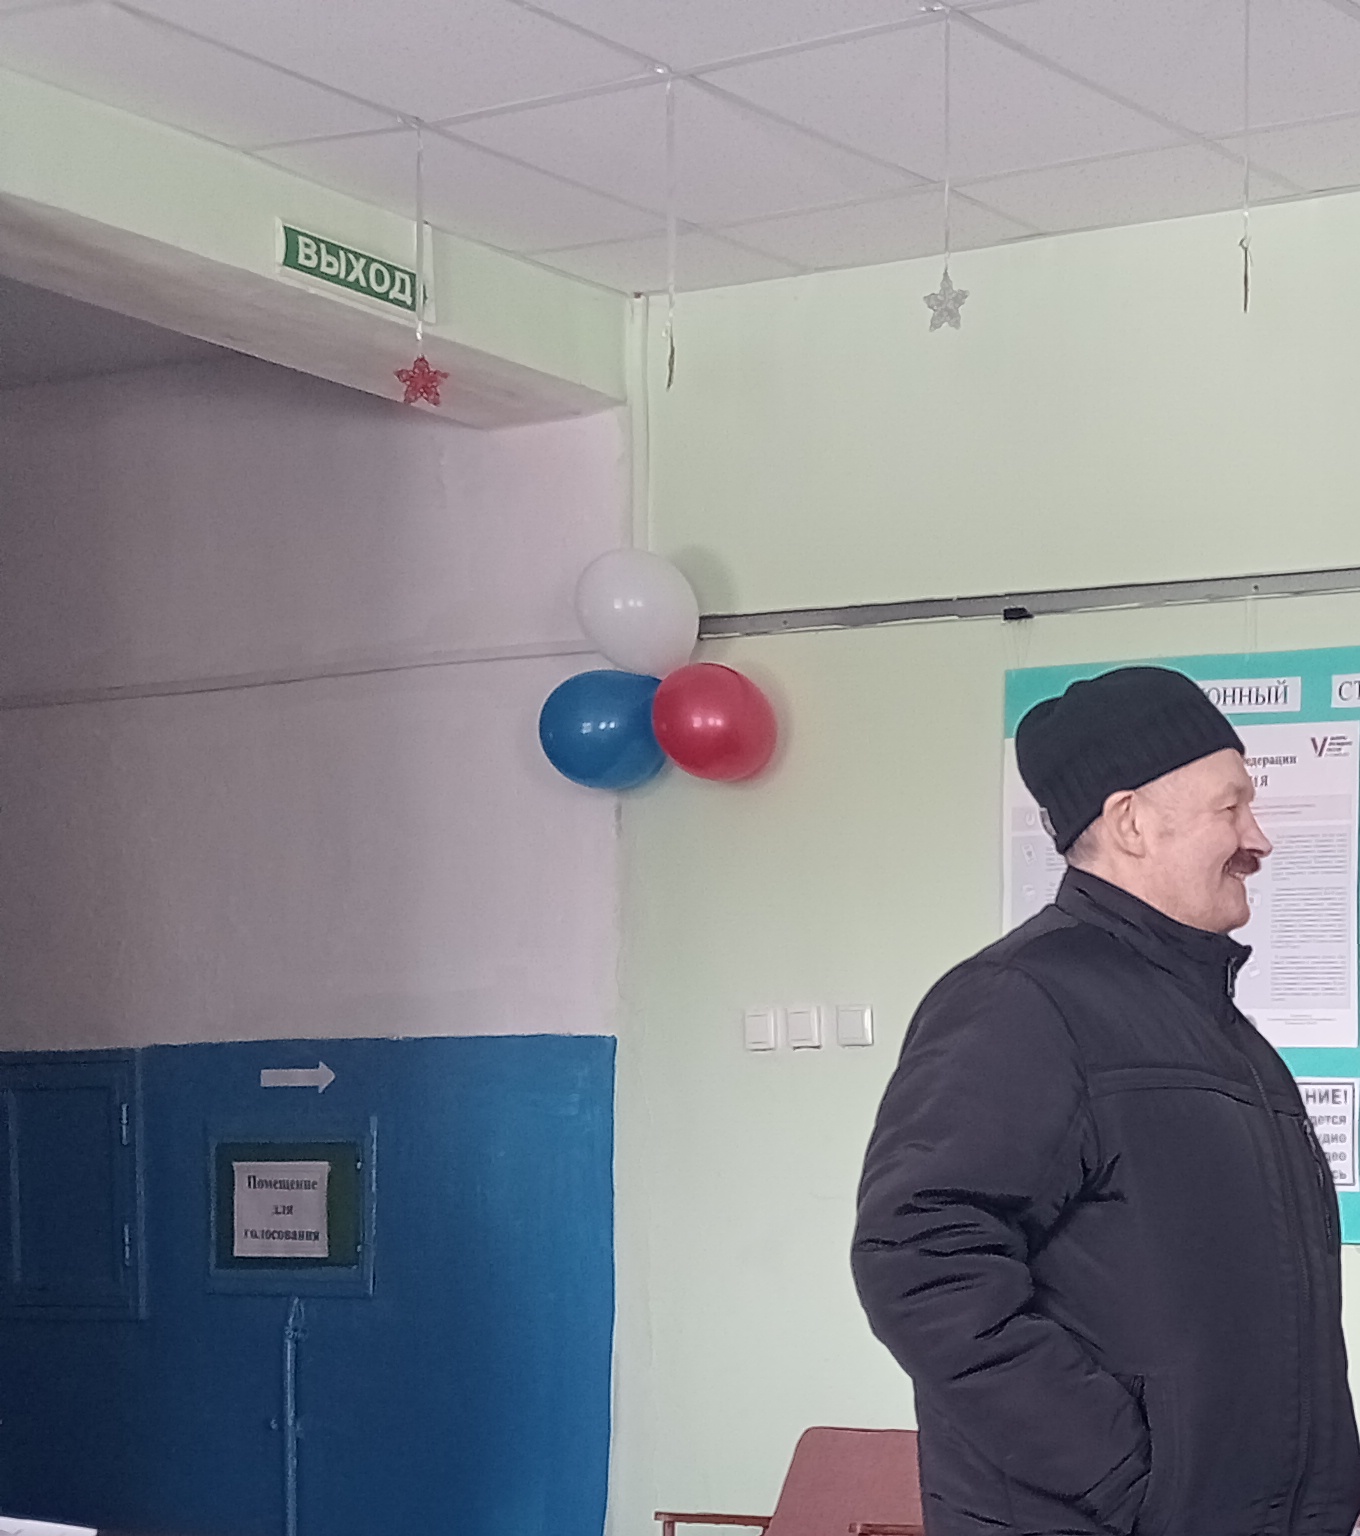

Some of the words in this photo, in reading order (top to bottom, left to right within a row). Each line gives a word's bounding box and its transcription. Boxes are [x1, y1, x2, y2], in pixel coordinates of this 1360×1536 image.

[297, 235, 412, 306] ВЫХОД
[1204, 679, 1288, 706] ОННЫЙ
[1245, 756, 1297, 768] едерации
[1305, 1089, 1347, 1104] НИЕ!
[1310, 1115, 1347, 1126] дется
[1319, 1133, 1347, 1144] дио
[247, 1174, 318, 1190] Помещение
[272, 1205, 293, 1215] для
[244, 1228, 319, 1241] голосования
